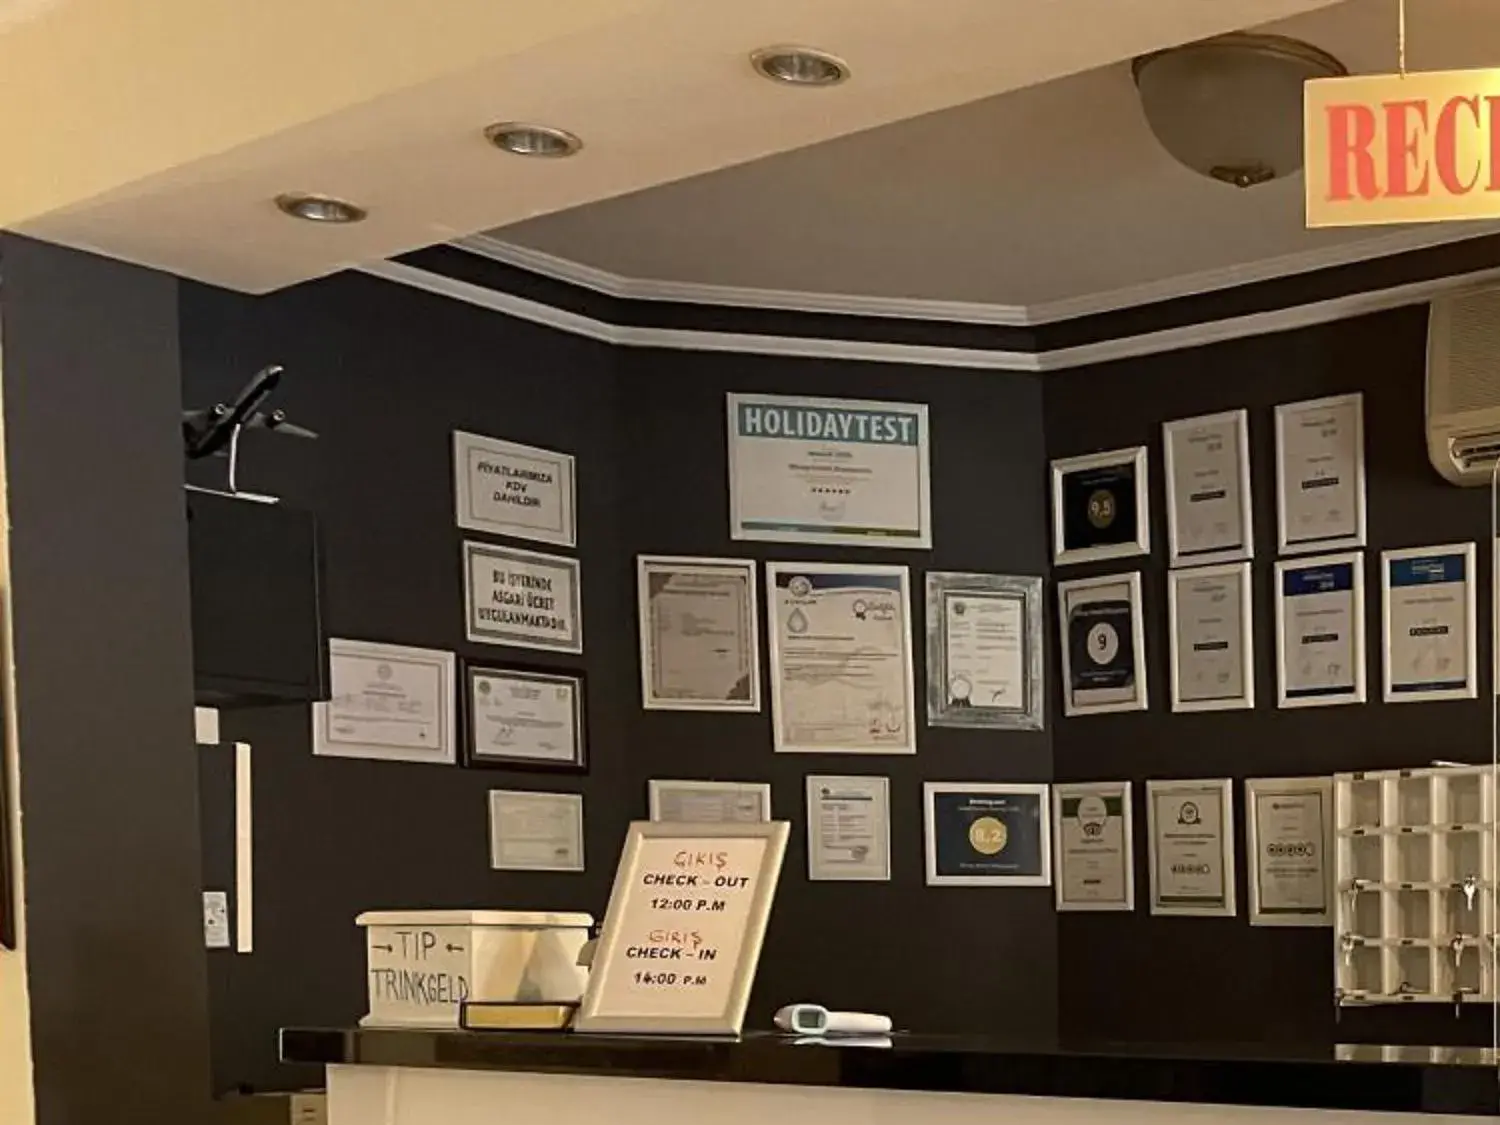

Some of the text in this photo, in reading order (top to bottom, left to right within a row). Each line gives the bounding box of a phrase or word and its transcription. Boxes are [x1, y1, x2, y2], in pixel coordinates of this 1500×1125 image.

[643, 873, 698, 886] CHECK
[714, 875, 750, 888] OUT
[651, 897, 693, 911] 12:00
[393, 931, 436, 961] TIP
[626, 946, 682, 959] CHECK
[698, 948, 717, 961] IN
[370, 967, 469, 1004] TRINKGELD
